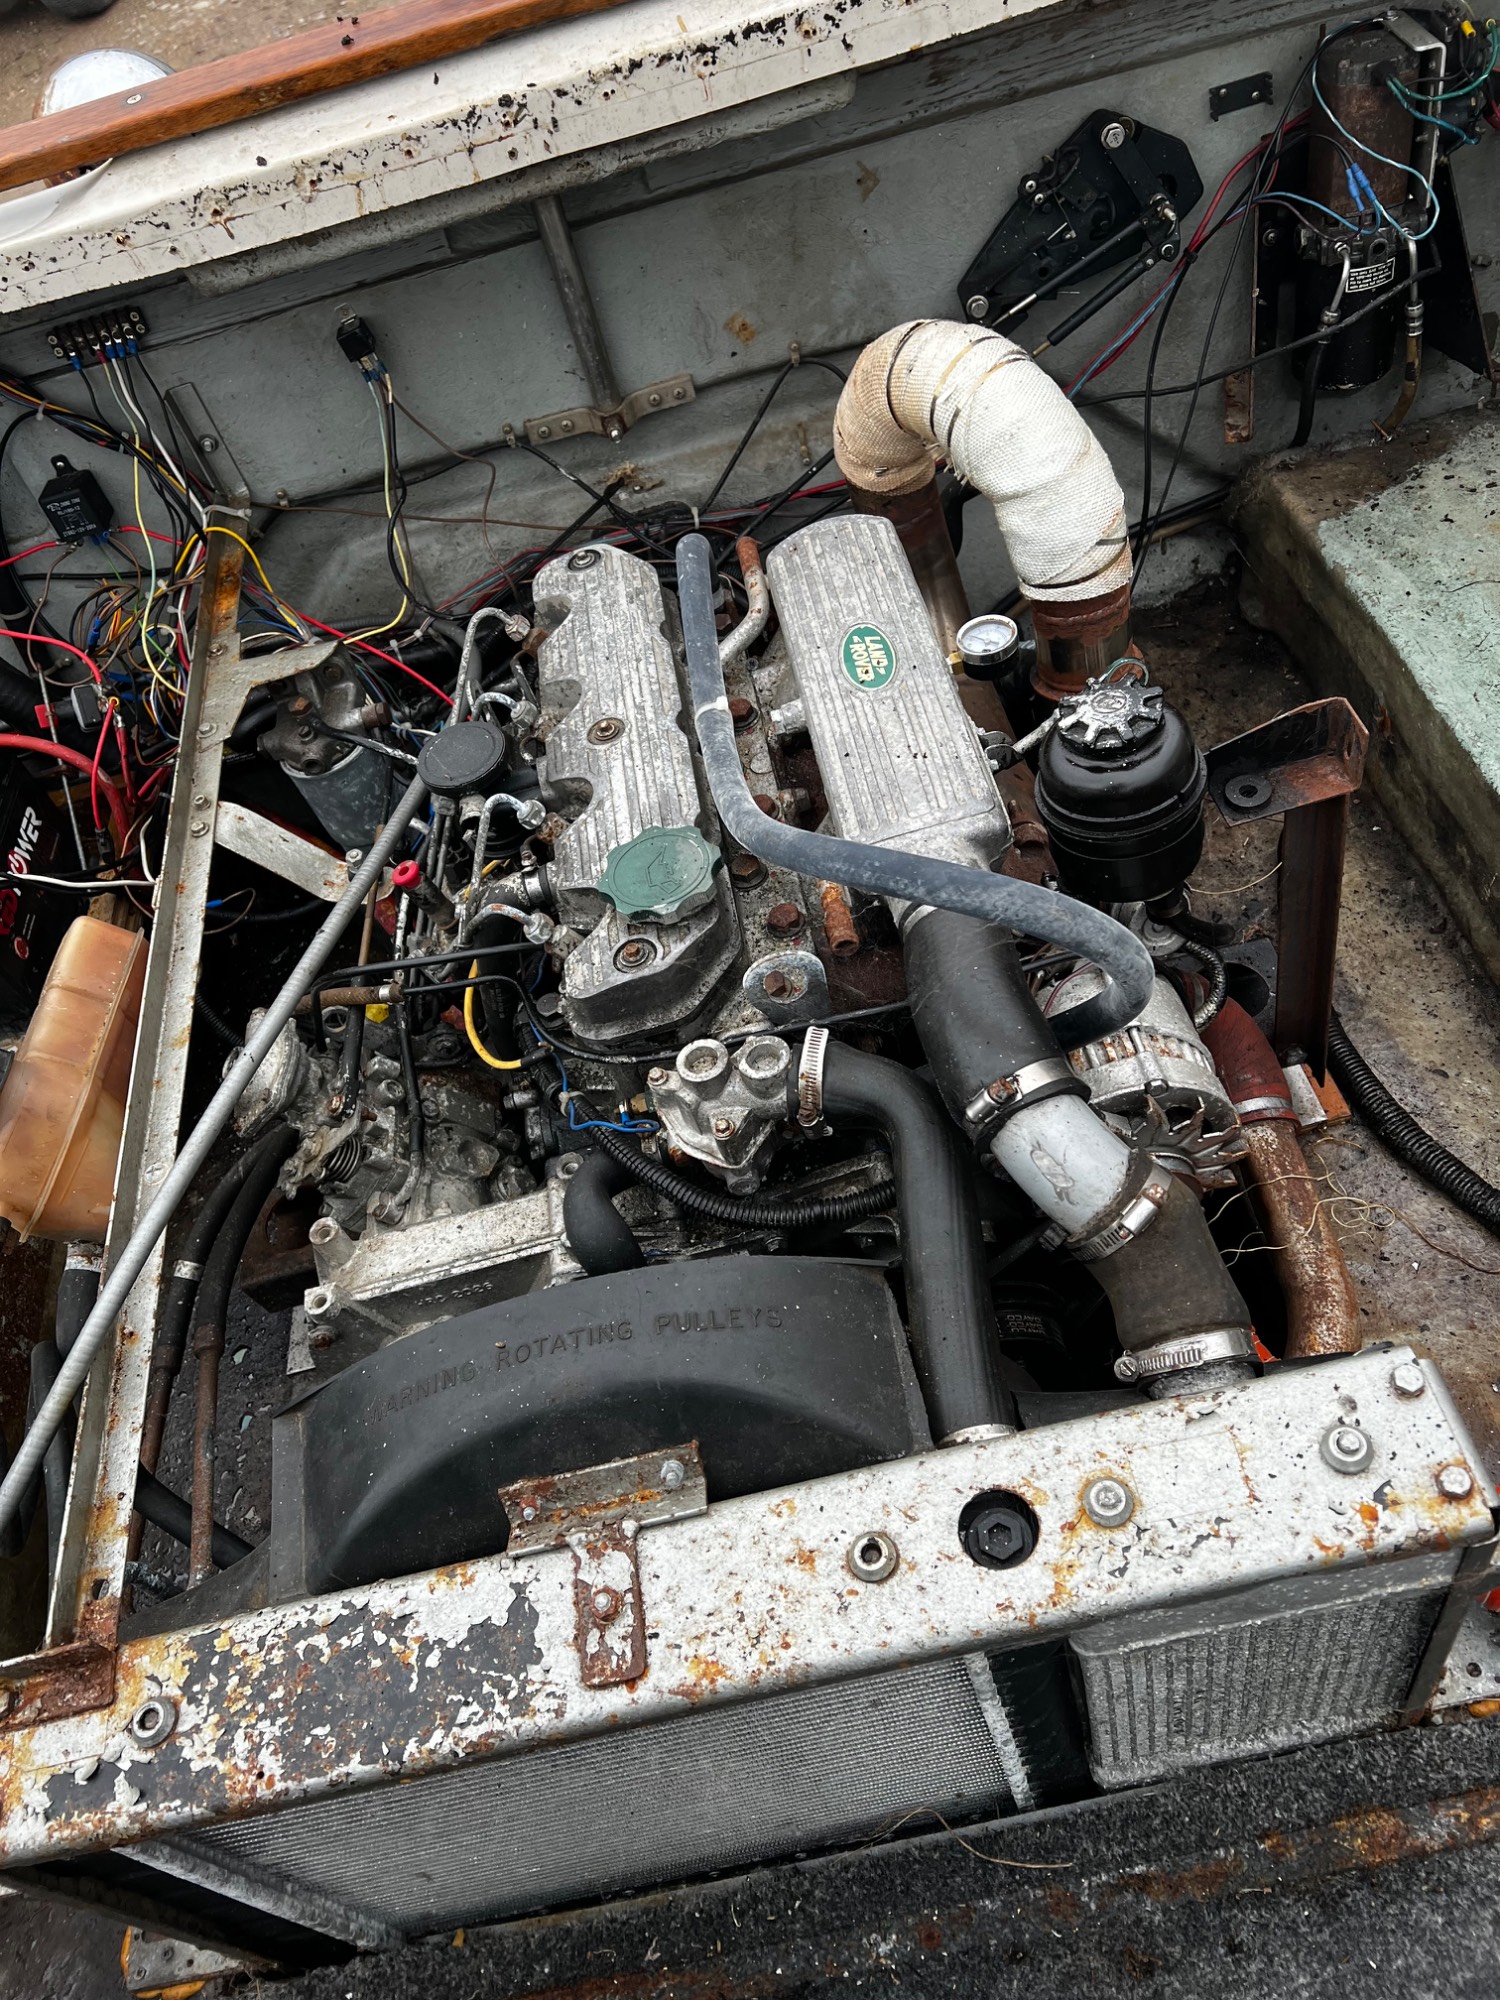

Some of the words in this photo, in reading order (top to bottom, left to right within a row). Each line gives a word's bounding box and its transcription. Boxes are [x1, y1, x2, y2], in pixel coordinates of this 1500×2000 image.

[849, 643, 875, 681] ROVER
[864, 636, 889, 668] LAND
[366, 1361, 476, 1425] WARNING
[496, 1320, 634, 1371] ROTATING
[656, 1308, 782, 1335] PULLEYS
